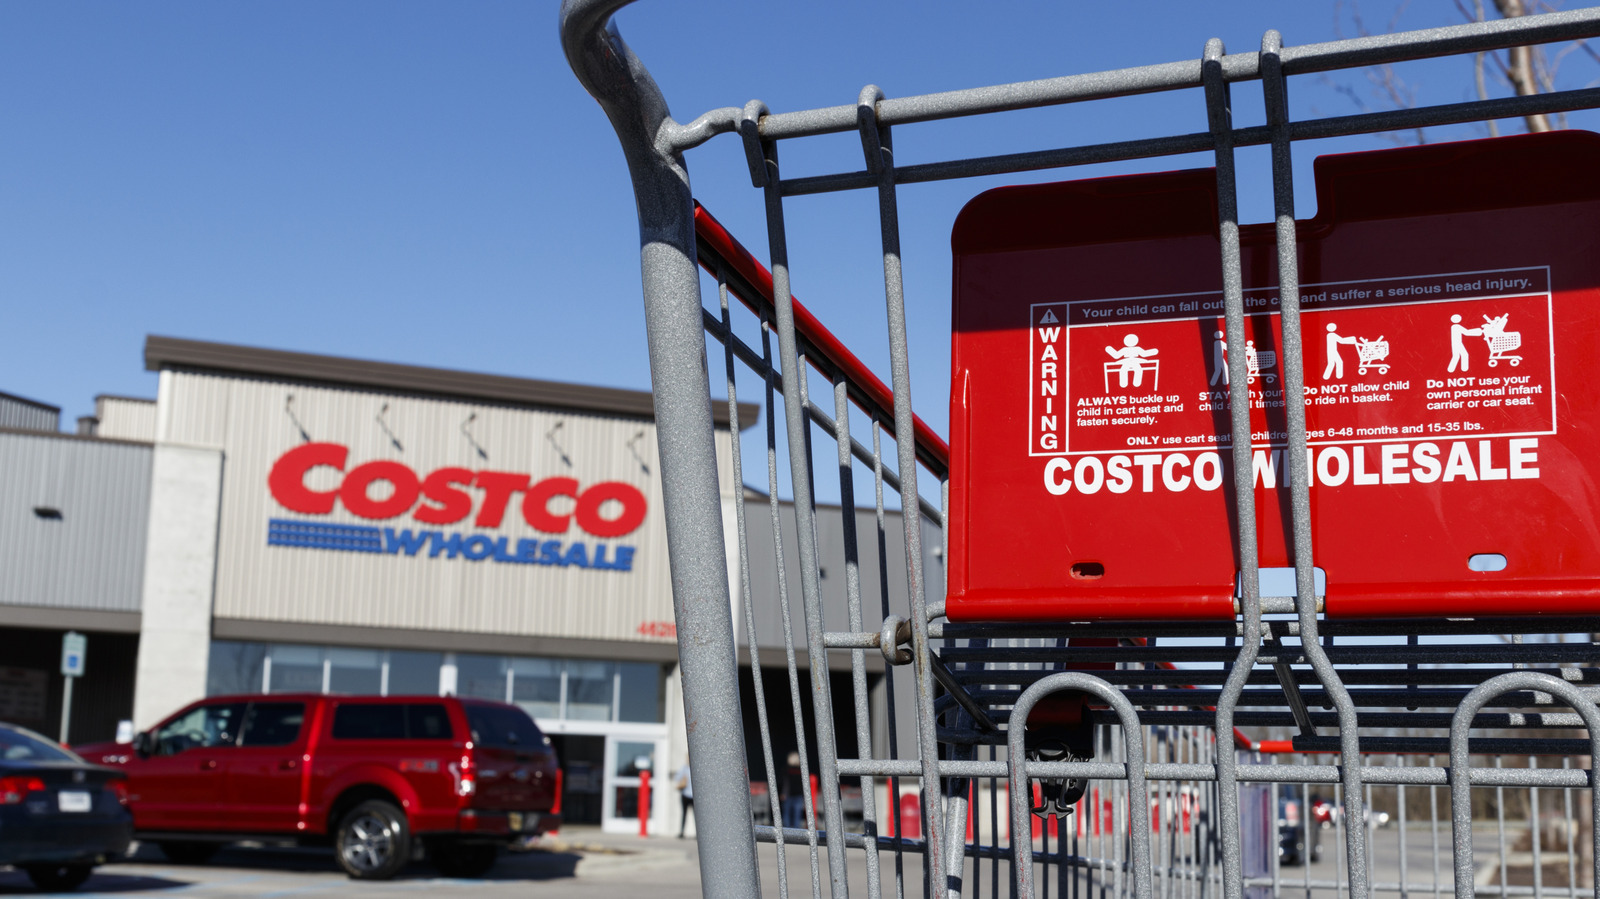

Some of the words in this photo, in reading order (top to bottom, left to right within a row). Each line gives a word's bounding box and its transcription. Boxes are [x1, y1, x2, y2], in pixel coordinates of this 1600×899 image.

[1082, 308, 1114, 318] Your
[1116, 304, 1148, 316] child
[1151, 304, 1175, 314] can
[1179, 301, 1198, 312] fall
[1202, 300, 1224, 310] out
[1246, 297, 1266, 306] the
[1301, 292, 1326, 303] and
[1330, 289, 1372, 300] suffer
[1375, 289, 1384, 298] a
[1388, 284, 1441, 296] serious
[1446, 281, 1482, 293] head
[1486, 277, 1532, 291] injury.
[1038, 327, 1059, 450] WARNING
[1304, 386, 1318, 395] Do
[1321, 384, 1348, 394] NOT
[1350, 382, 1380, 393] allow
[1383, 381, 1410, 391] child
[1426, 379, 1444, 389] Do
[1447, 377, 1476, 388] NOT
[1479, 376, 1500, 386] use
[1504, 375, 1530, 386] your
[1198, 392, 1230, 400] STAY
[1259, 390, 1283, 399] your
[1315, 396, 1336, 405] ride
[1339, 395, 1349, 404] in
[1352, 392, 1393, 403] basket.
[1426, 390, 1451, 399] own
[1454, 386, 1505, 399] personal
[1508, 384, 1542, 394] infant
[1077, 396, 1127, 406] ALWAYS
[1129, 394, 1164, 404] buckle
[1166, 394, 1179, 404] up
[1199, 402, 1223, 411] child
[1256, 399, 1285, 408] times
[1426, 400, 1465, 410] carrier
[1467, 400, 1480, 408] or
[1482, 399, 1502, 407] car
[1505, 396, 1534, 406] seat.
[1077, 406, 1102, 416] child
[1104, 406, 1113, 415] in
[1116, 405, 1136, 415] cart
[1138, 404, 1161, 414] seat
[1163, 403, 1183, 412] and
[1077, 416, 1109, 426] fasten
[1111, 415, 1158, 426] securely.
[1127, 436, 1159, 446] ONLY
[1162, 436, 1182, 444] use
[1184, 433, 1205, 444] cart
[1208, 433, 1231, 442] seat
[1251, 431, 1288, 440] childre
[1306, 430, 1325, 439] ges
[1327, 427, 1353, 437] 6-48
[1356, 425, 1398, 436] months
[1402, 423, 1423, 434] and
[1427, 422, 1460, 432] 15-35
[1464, 421, 1484, 431] lbs.
[1044, 452, 1224, 496] COSTCO
[268, 442, 647, 538] COSTCO
[380, 527, 636, 572] WHOLESALE
